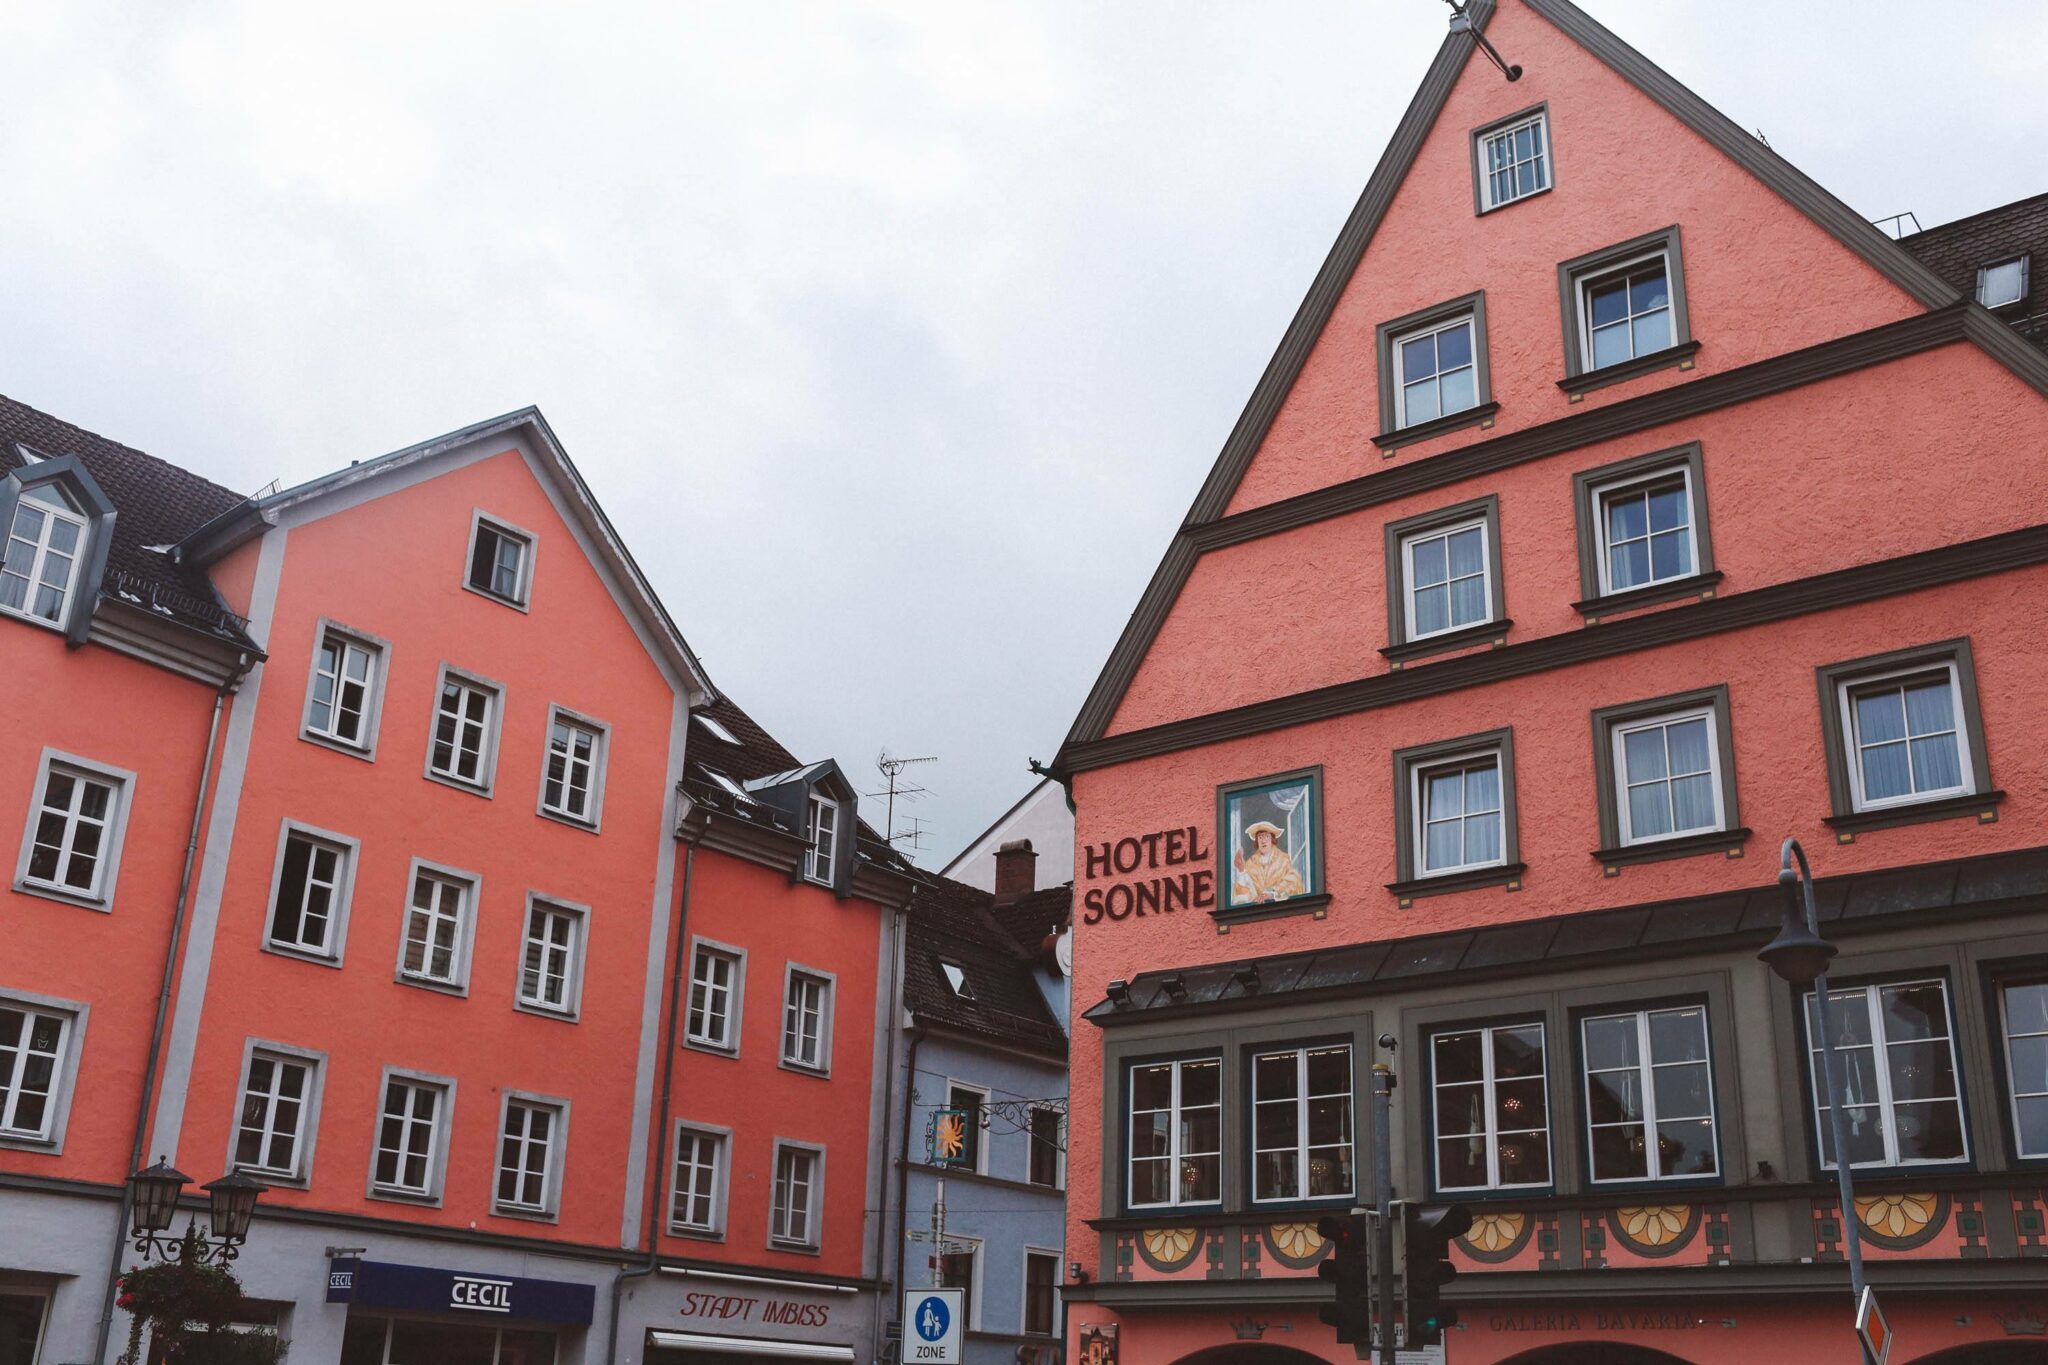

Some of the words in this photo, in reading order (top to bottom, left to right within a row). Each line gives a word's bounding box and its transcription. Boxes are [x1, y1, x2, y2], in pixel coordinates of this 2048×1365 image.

[1084, 826, 1209, 879] HOTEL
[1083, 870, 1215, 925] SONNE
[330, 1275, 352, 1286] CECIL
[452, 1282, 511, 1307] CECIL
[680, 1292, 759, 1321] STADT
[762, 1300, 830, 1327] IMBISS
[1489, 1312, 1582, 1331] GALERIA
[1596, 1311, 1698, 1330] BAVARIA
[916, 1346, 946, 1359] ZONE
